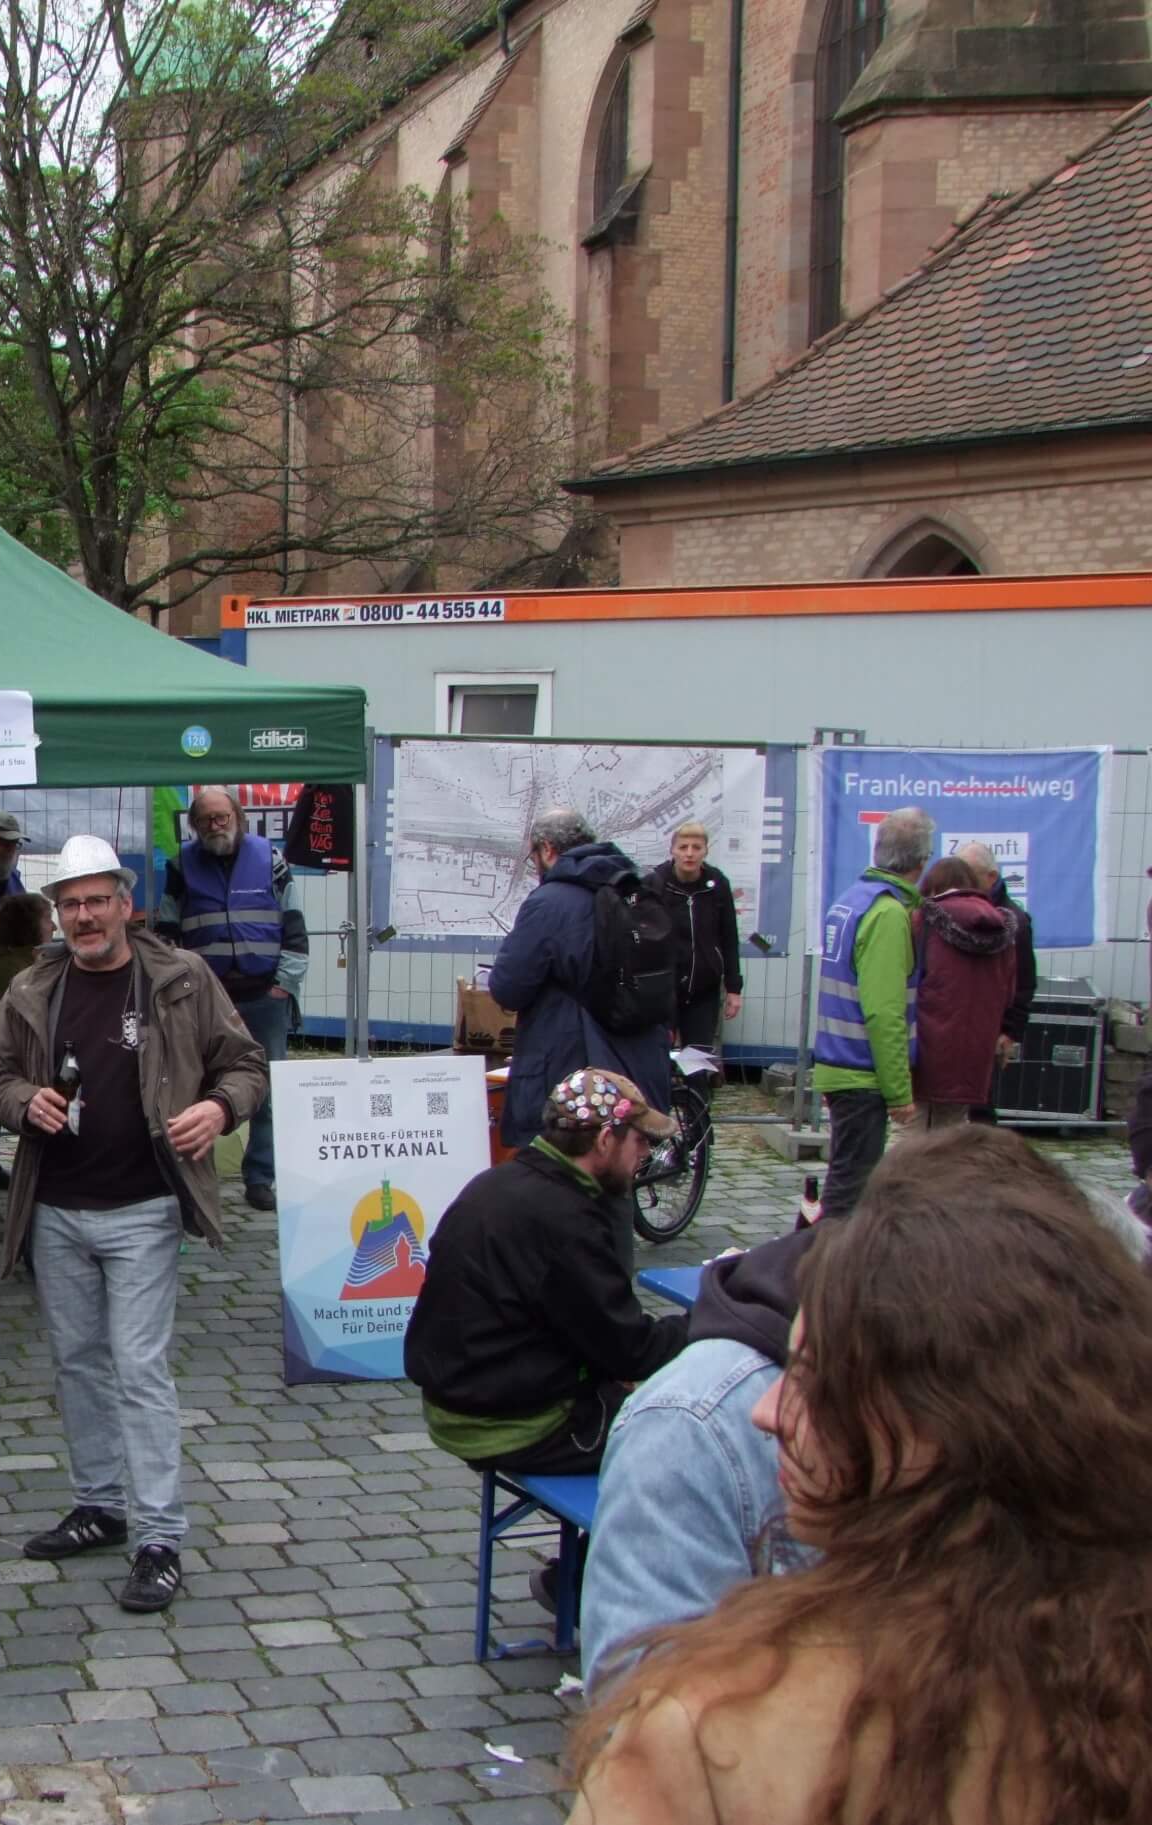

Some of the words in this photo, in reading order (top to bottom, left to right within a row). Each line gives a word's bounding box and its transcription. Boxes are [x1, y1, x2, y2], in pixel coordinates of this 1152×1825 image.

[247, 610, 271, 625] HKL
[275, 608, 341, 624] MIETPARK
[360, 604, 403, 622] 0800
[187, 736, 205, 747] 120
[252, 730, 305, 748] stilista
[9, 757, 26, 766] Stau
[844, 772, 1075, 800] Frankenschnellweg
[322, 1129, 444, 1143] NÜRNBERG-FÜRTHER
[318, 1141, 449, 1161] STADTKANAL
[314, 1306, 348, 1320] Mach
[352, 1304, 373, 1318] mit
[377, 1303, 401, 1317] und
[342, 1322, 363, 1335] Für
[367, 1319, 404, 1334] Deine
